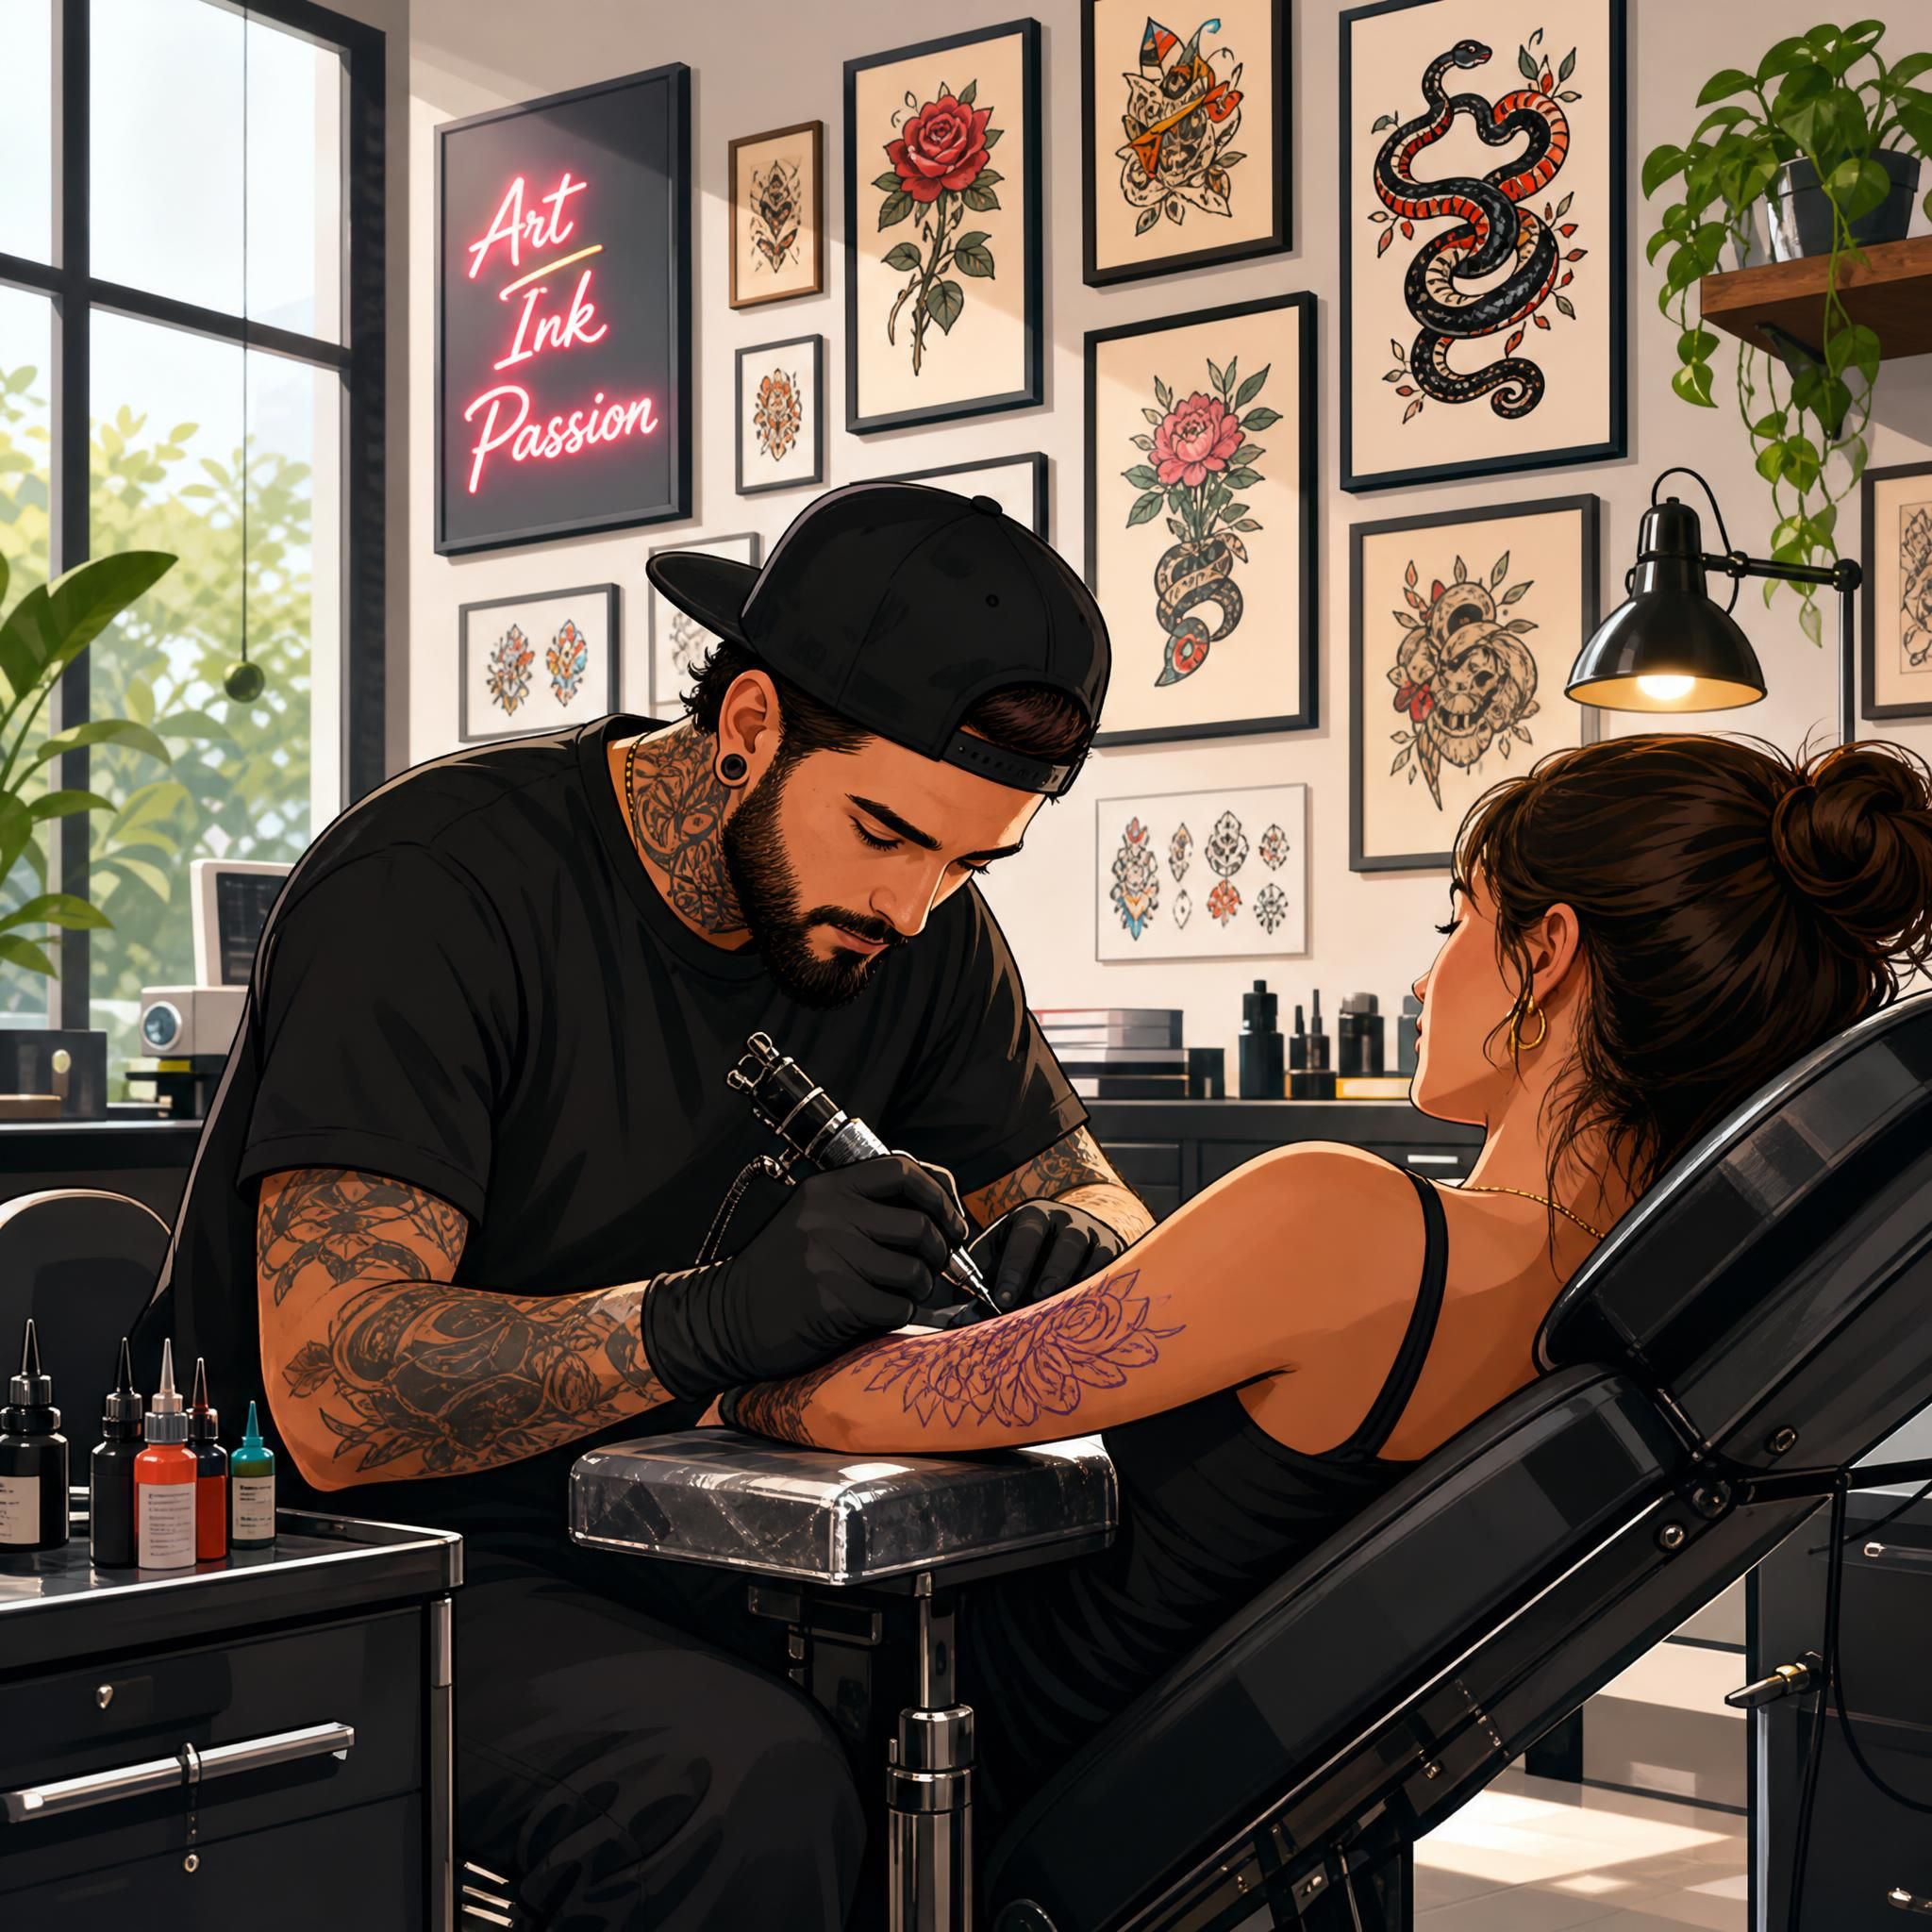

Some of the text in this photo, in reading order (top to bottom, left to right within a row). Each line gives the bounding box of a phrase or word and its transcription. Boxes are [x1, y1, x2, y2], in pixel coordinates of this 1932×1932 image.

[469, 173, 588, 279] Art
[493, 270, 608, 371] Ink
[464, 385, 658, 493] Passion
